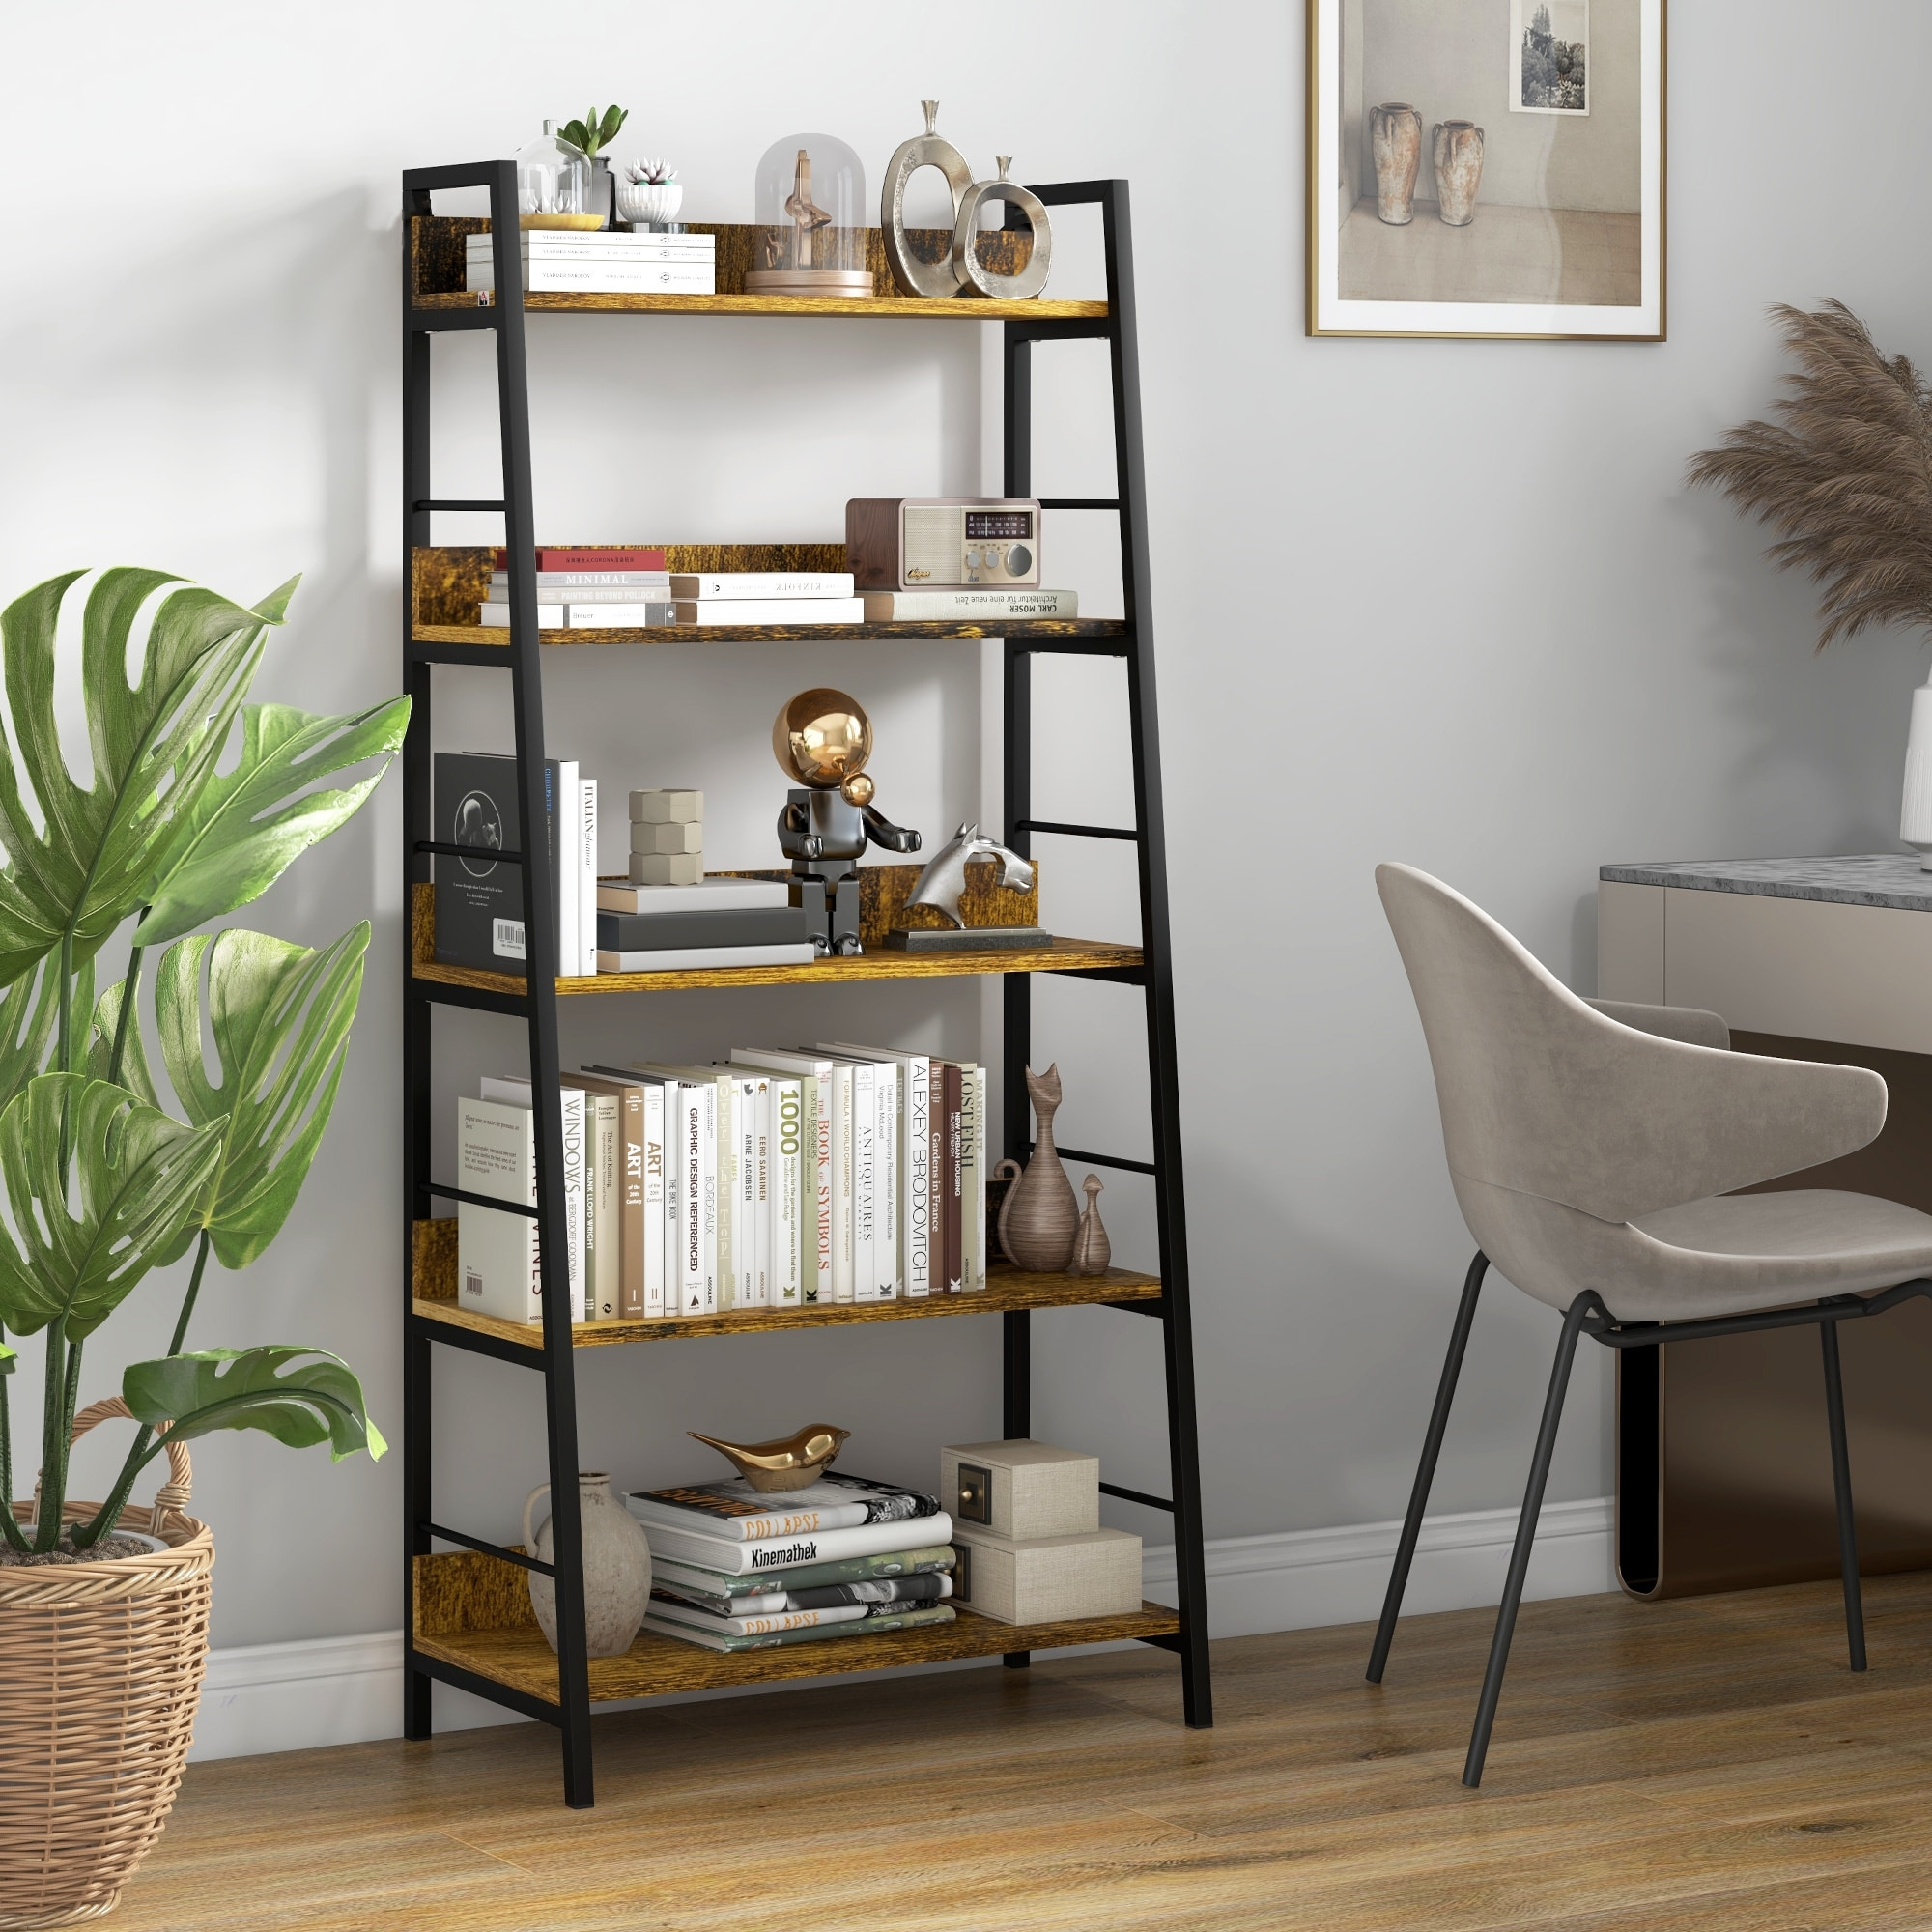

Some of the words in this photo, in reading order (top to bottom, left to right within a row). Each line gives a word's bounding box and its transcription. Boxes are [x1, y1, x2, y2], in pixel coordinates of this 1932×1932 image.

[561, 591, 593, 600] PAINTING
[595, 591, 623, 600] BEYOND
[566, 574, 628, 584] MINIMAL
[954, 596, 969, 605] Zeit
[585, 786, 594, 832] ITALIAN
[913, 1065, 926, 1142] ALEXEY
[961, 1069, 974, 1120] LOST
[690, 1107, 698, 1155] GRAPHIC
[781, 1090, 800, 1155] 1000
[565, 1098, 581, 1193] WINDOWS
[628, 1142, 641, 1179] ART
[648, 1141, 662, 1177] ART
[818, 1120, 830, 1167] BOOK
[932, 1132, 941, 1179] Gardens
[961, 1126, 974, 1168] FISH
[977, 1138, 983, 1151] IT
[690, 1159, 698, 1198] DESIGN
[818, 1171, 824, 1181] OF
[862, 1126, 872, 1241] ANTIQUAIRES
[932, 1180, 941, 1192] in
[568, 1204, 577, 1241] BERGDORF
[705, 1176, 715, 1235] BORDEAUX
[913, 1150, 926, 1282] BRODOVITCH
[932, 1194, 941, 1233] France
[690, 1202, 698, 1271] REFERENCED
[818, 1186, 830, 1270] SYMBOLS
[568, 1242, 577, 1281] GOODMAN
[746, 1511, 820, 1541] COLLAPSE
[752, 1541, 817, 1569] Kinemathek
[746, 1611, 820, 1635] COLLAPSE
